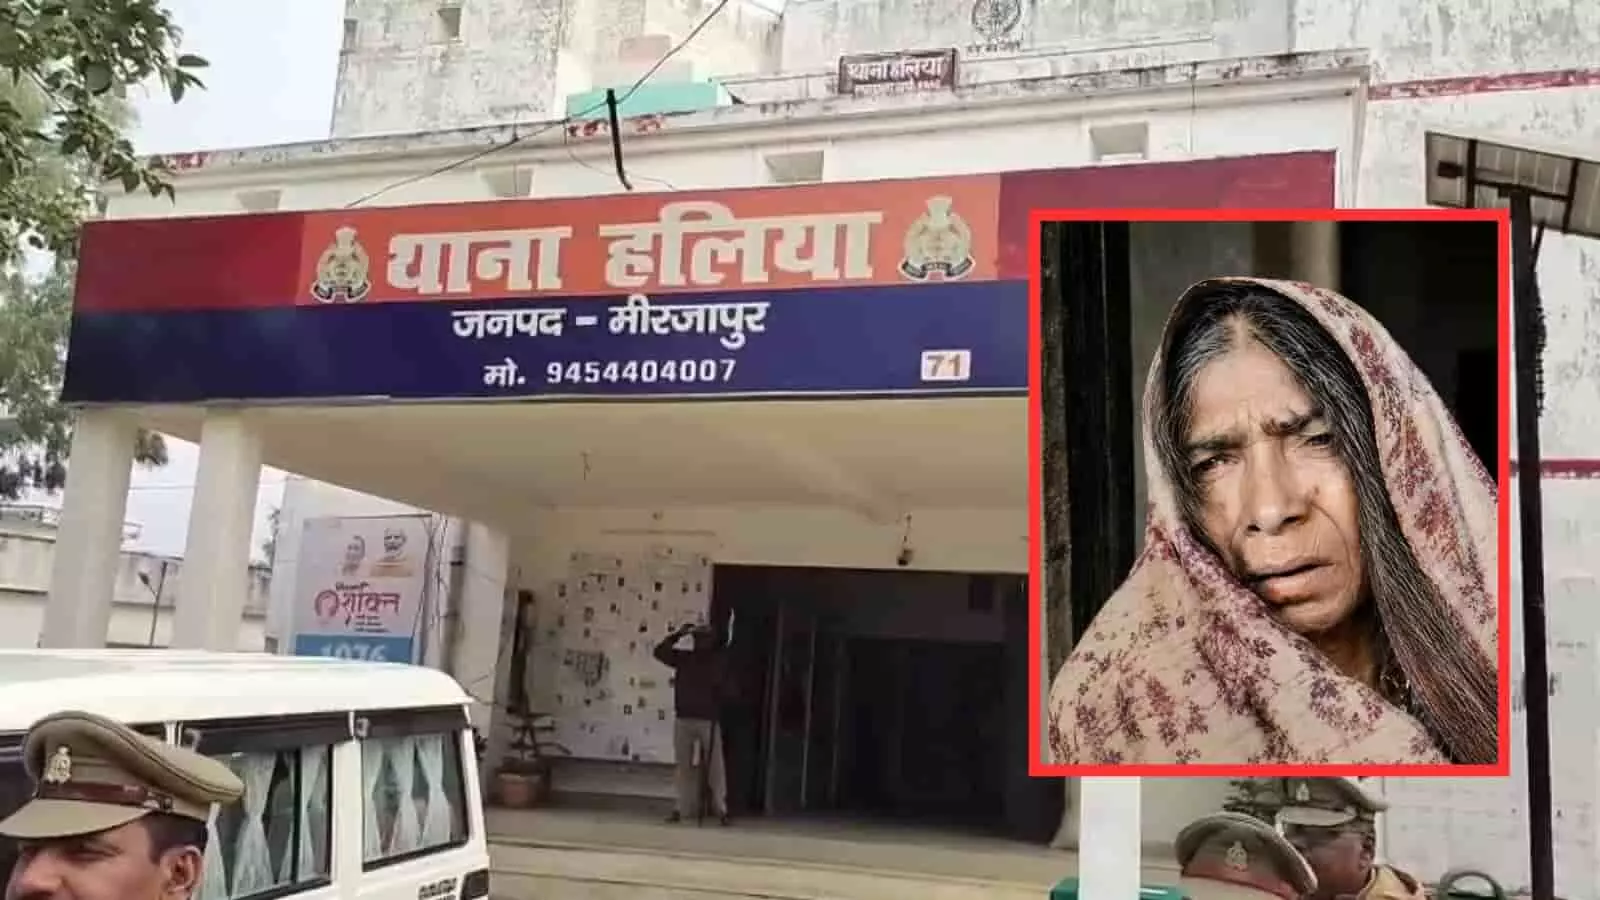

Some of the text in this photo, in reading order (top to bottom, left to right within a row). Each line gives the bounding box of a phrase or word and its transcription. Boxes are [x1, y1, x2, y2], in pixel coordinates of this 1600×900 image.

[386, 200, 884, 295] थाना हलिया
[452, 307, 568, 339] जनपद
[607, 294, 771, 350] मीरजापुर
[483, 357, 737, 387] मो. 9454404007
[926, 353, 963, 378] 71
